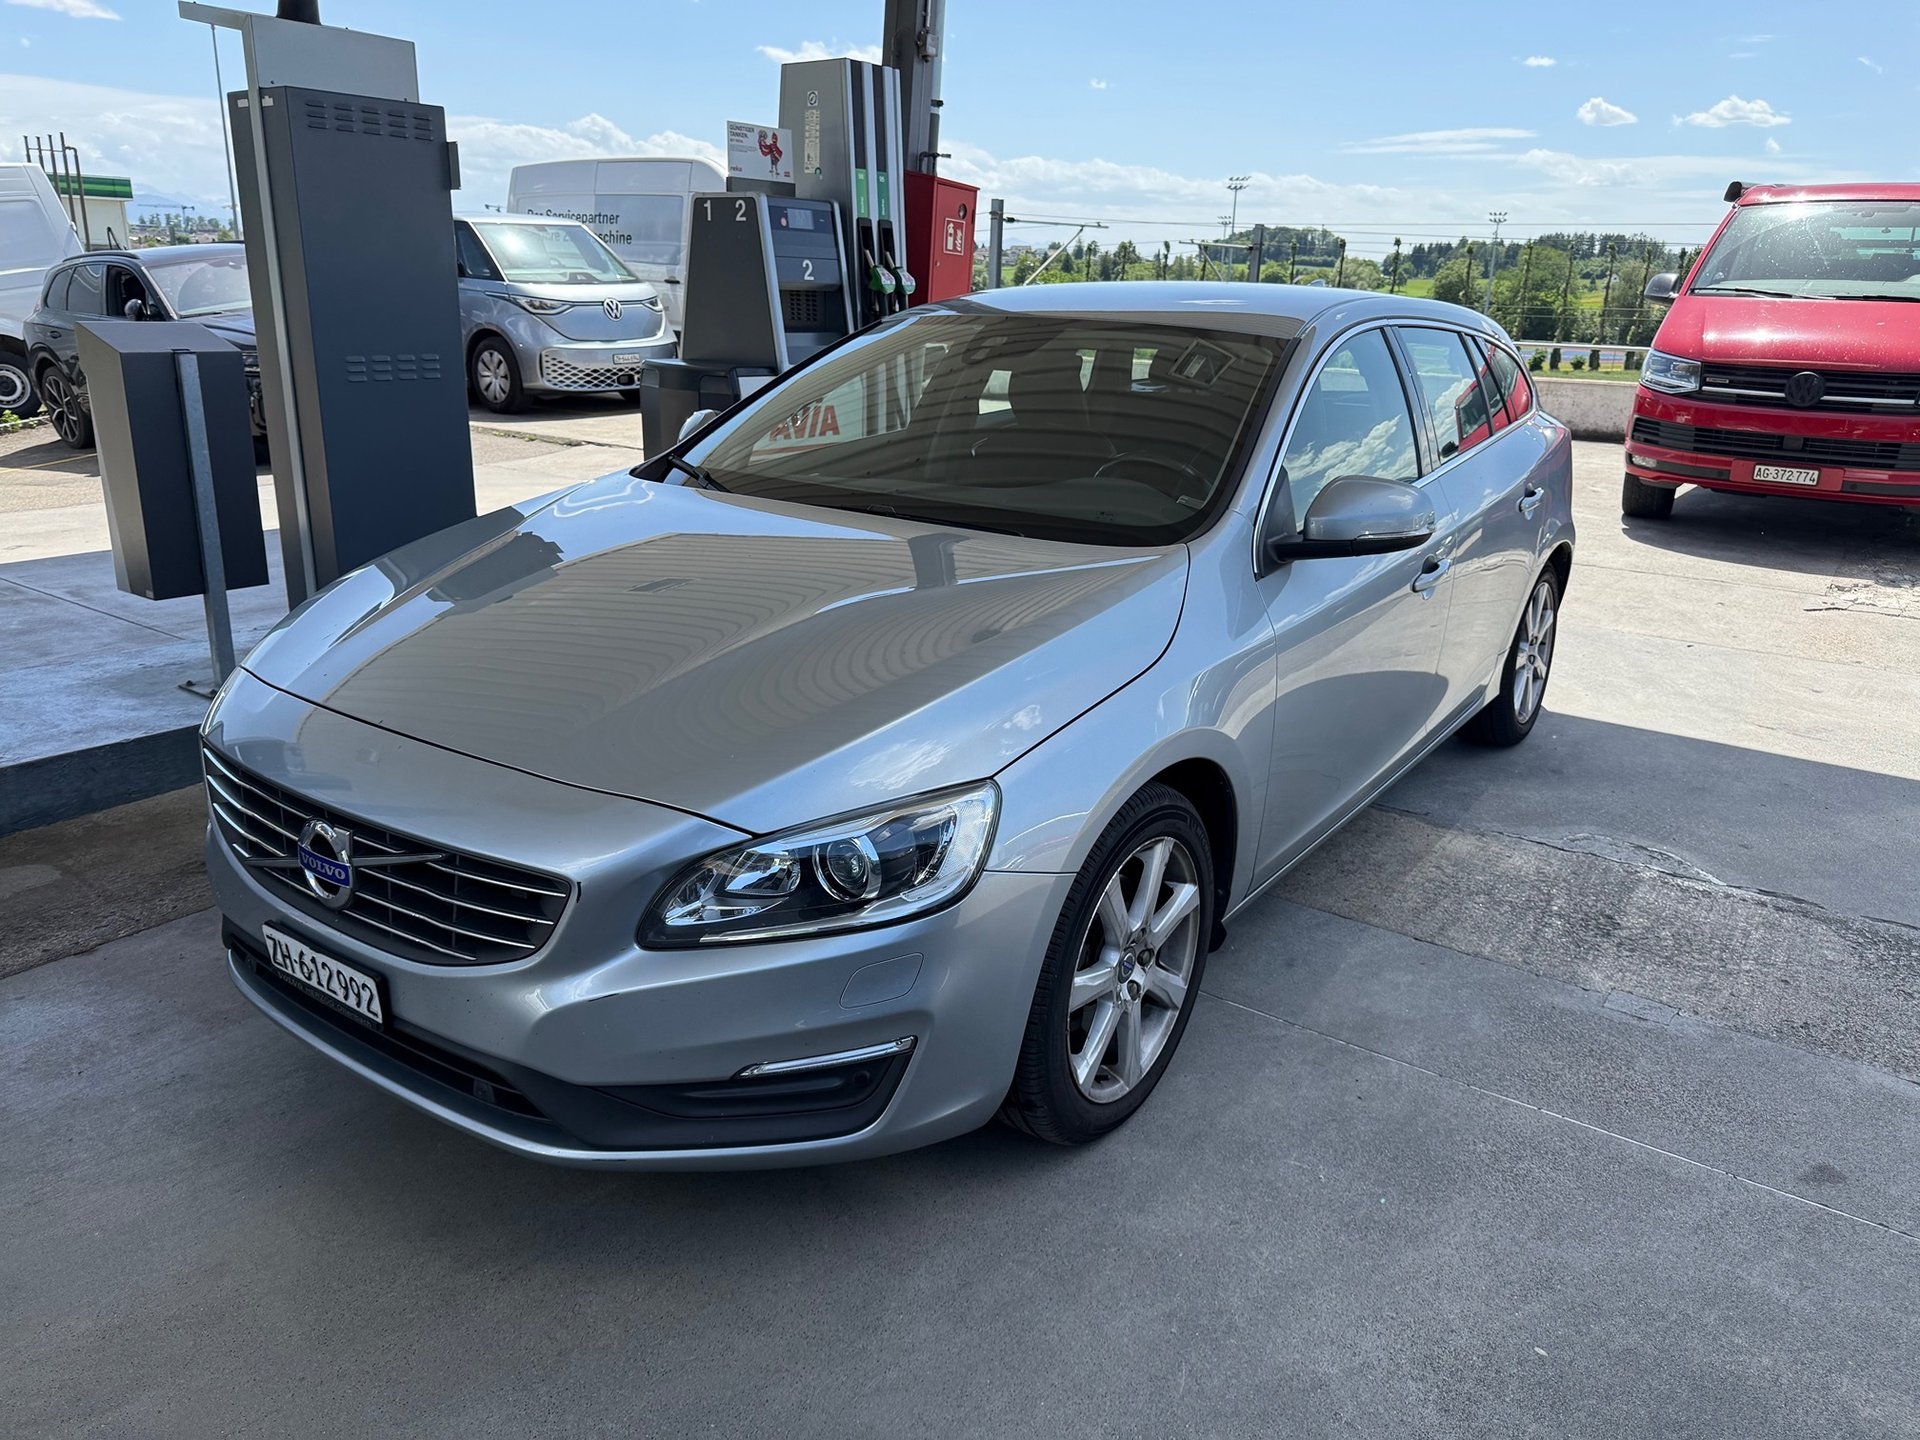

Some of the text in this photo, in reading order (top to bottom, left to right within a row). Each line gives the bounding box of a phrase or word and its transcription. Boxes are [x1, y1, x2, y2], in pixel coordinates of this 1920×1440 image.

[703, 200, 747, 221] 1 2
[802, 260, 815, 281] 2
[603, 297, 623, 321] VW
[769, 404, 840, 441] AVIA
[301, 851, 346, 880] VOLVO
